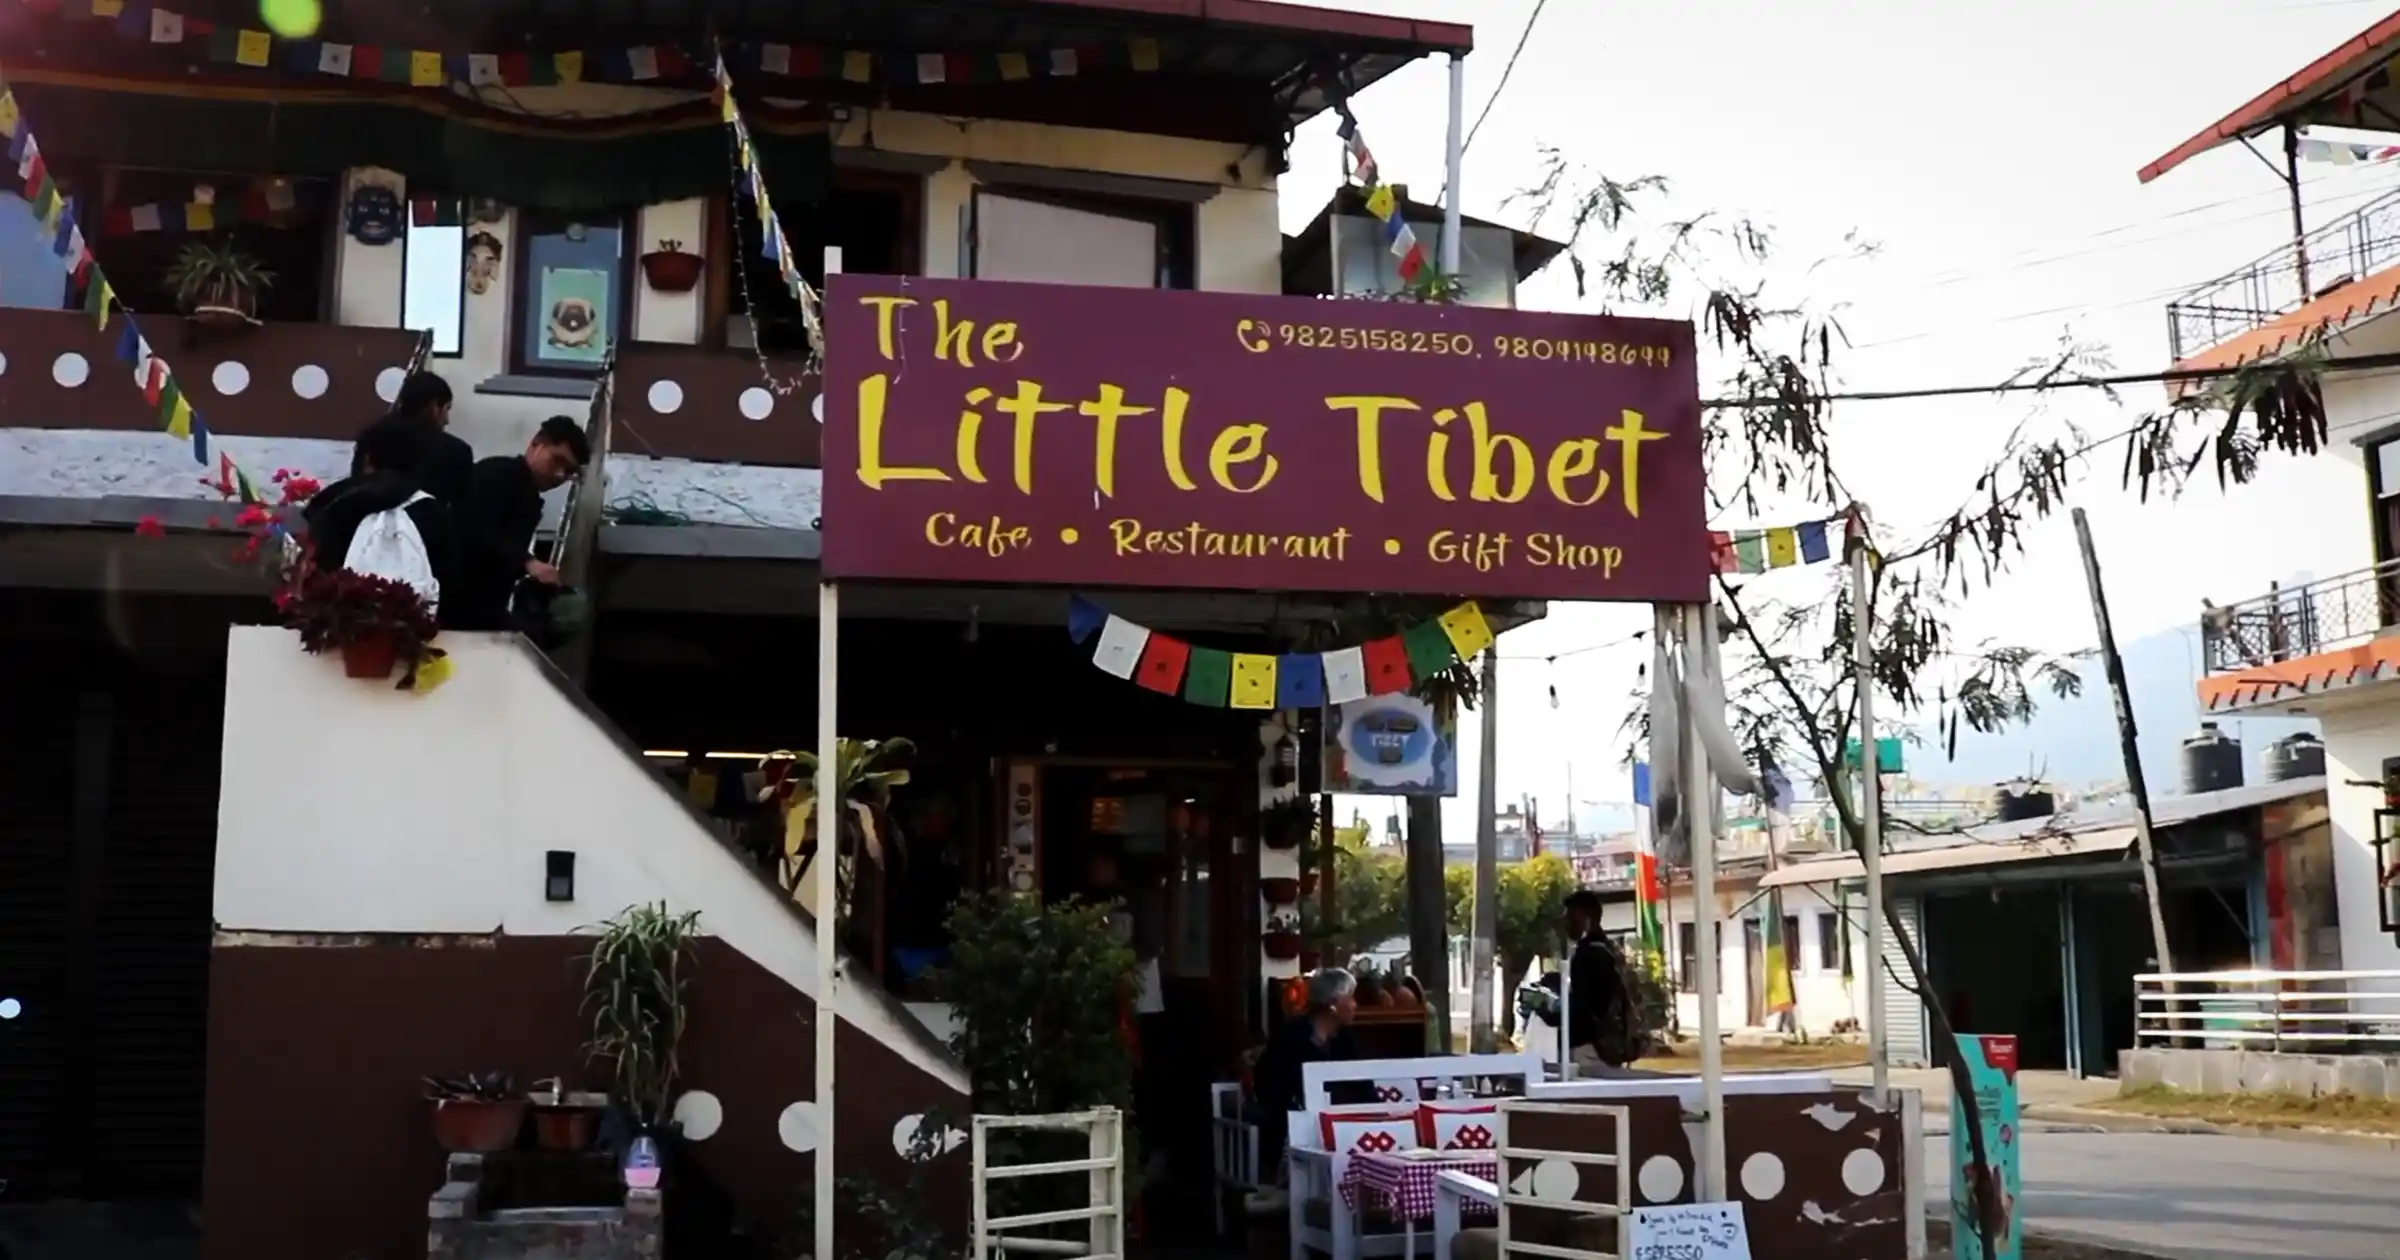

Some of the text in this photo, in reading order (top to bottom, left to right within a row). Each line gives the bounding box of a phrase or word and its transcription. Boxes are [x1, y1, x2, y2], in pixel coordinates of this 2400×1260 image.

[859, 296, 1023, 368] The
[856, 374, 1670, 518] Little Tibet
[925, 512, 1624, 578] Cafe Restaurant Gift Shop
